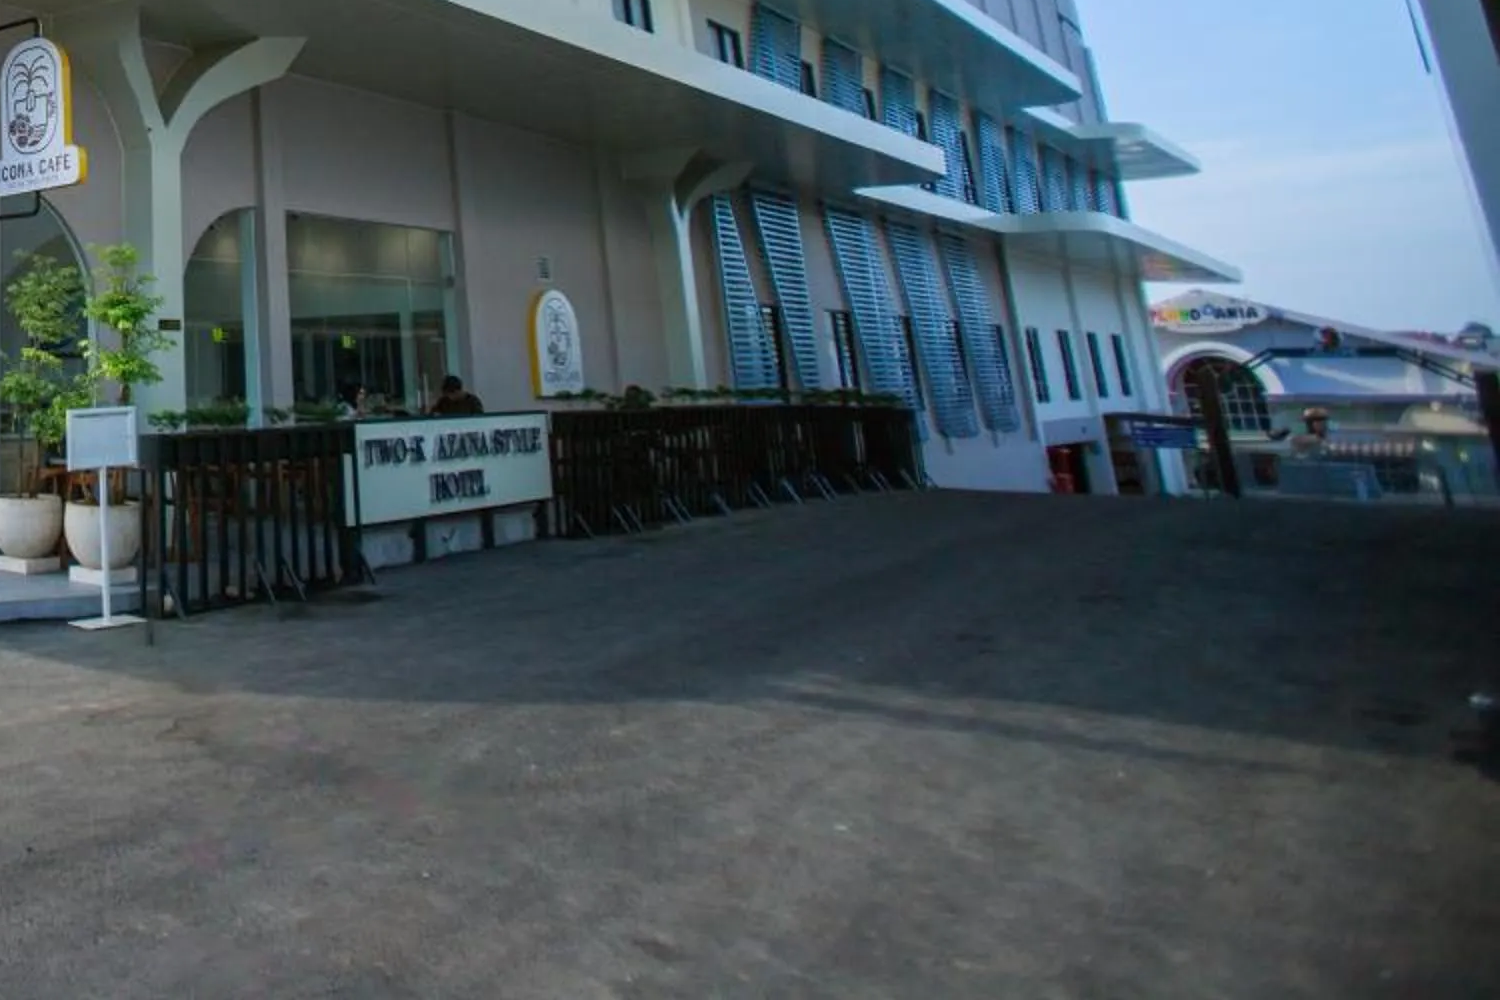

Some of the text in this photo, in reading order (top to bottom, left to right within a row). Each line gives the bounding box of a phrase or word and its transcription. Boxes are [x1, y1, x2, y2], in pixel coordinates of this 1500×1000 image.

[39, 153, 71, 174] CAFE
[363, 435, 427, 468] TWO-K
[491, 427, 542, 454] STYLE
[430, 469, 489, 503] HOTEL
